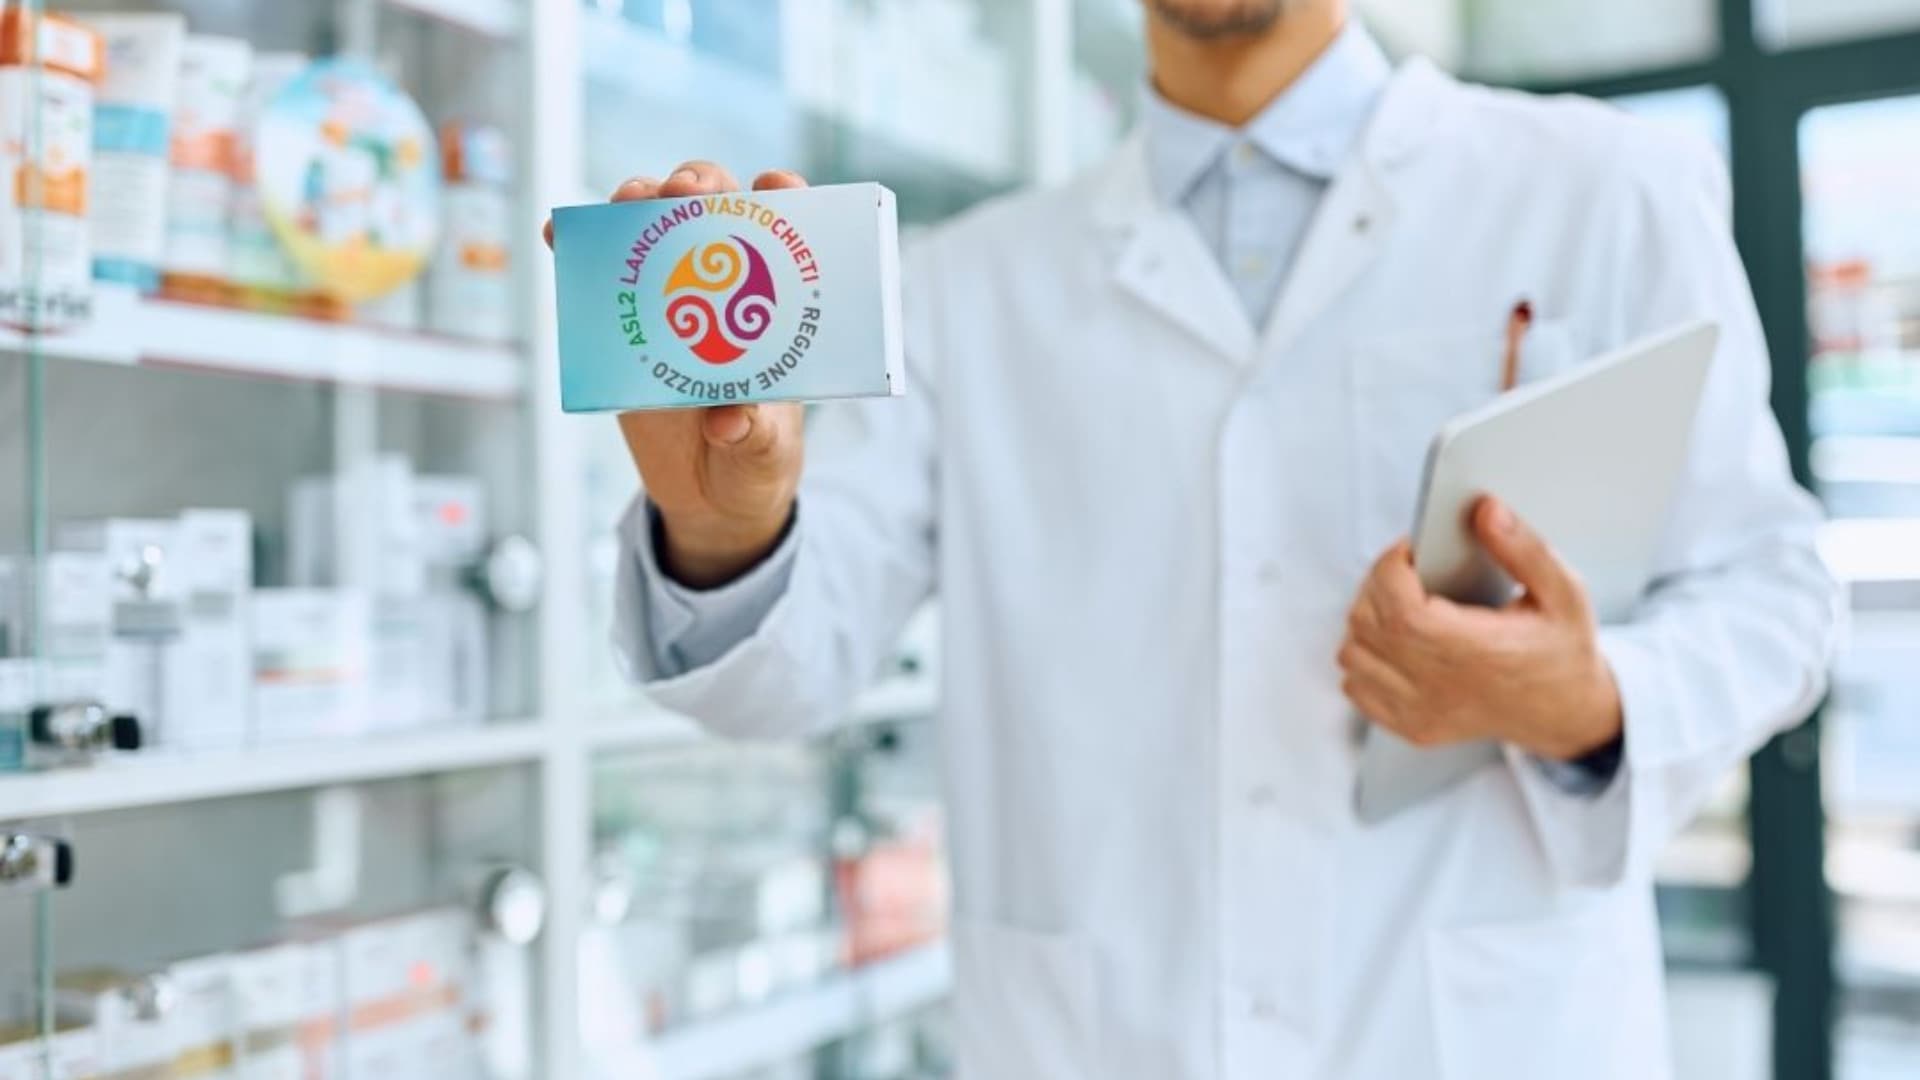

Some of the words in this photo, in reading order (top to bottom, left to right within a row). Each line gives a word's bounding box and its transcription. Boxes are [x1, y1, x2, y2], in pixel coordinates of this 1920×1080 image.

[618, 291, 646, 346] ASL2
[756, 307, 820, 390] REGIONE
[653, 361, 751, 399] ABRUZZO
